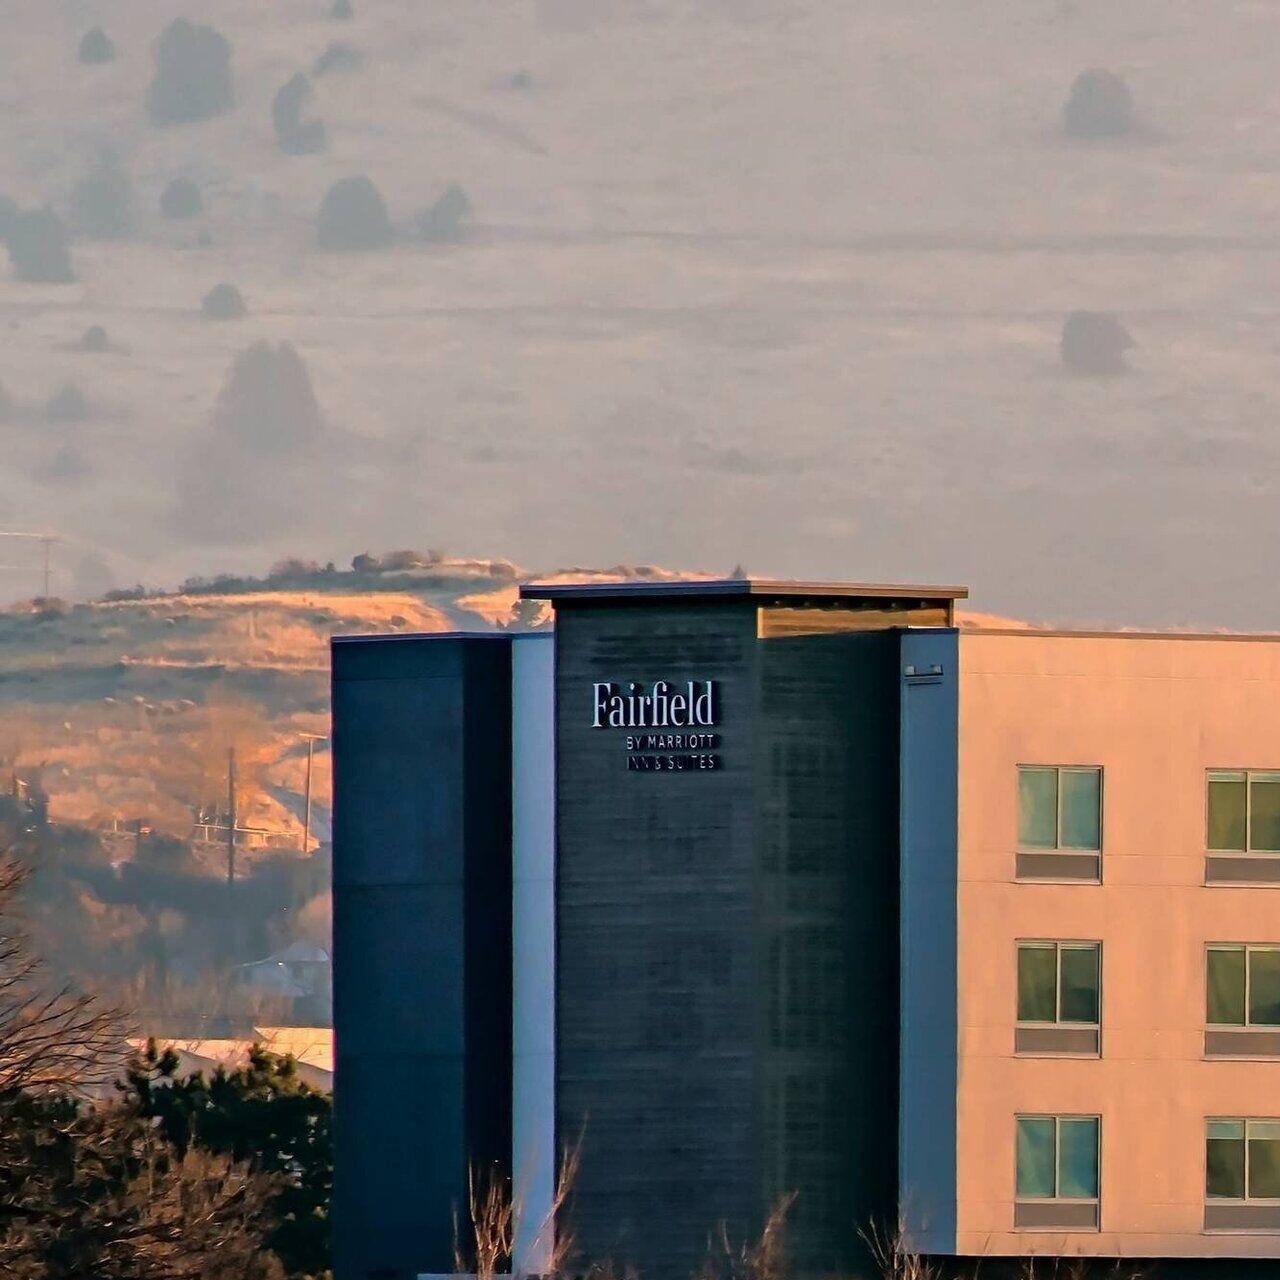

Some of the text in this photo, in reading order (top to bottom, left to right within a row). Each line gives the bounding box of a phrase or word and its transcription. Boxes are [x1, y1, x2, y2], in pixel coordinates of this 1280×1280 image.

[592, 681, 714, 728] Fairfield
[626, 734, 714, 750] BY MARRIOTT
[668, 755, 714, 769] SUTES
